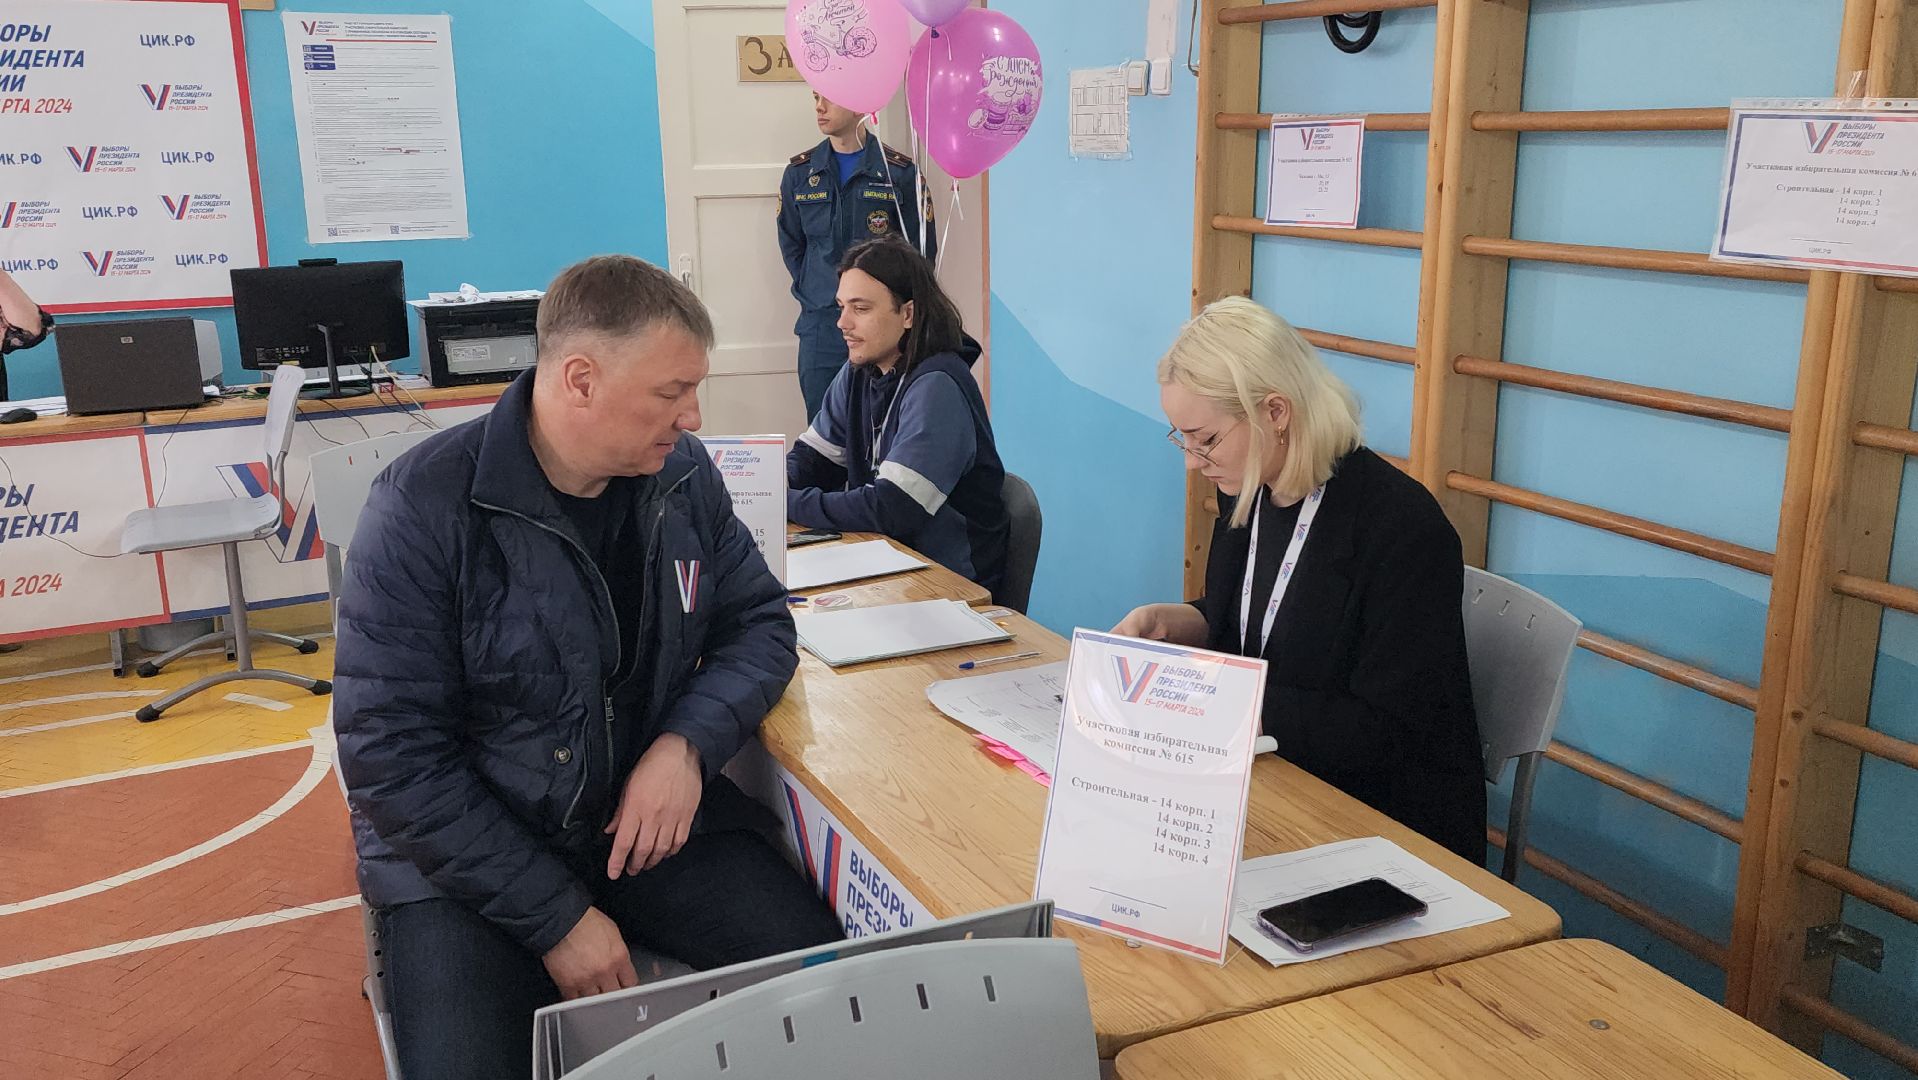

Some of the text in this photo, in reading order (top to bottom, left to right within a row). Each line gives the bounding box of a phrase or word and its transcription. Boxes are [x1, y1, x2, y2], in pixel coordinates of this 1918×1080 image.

[0, 24, 51, 42] ОРЫ
[140, 34, 195, 48] ЦИК.РФ
[0, 49, 84, 70] ИДЕНТА
[745, 37, 793, 75] ЗА
[1, 98, 72, 113] РТА 2024
[1836, 131, 1885, 140] ПРЕЗИДЕНТА
[1832, 140, 1863, 148] РОССИИ
[0, 153, 42, 165] ИК.РФ
[161, 151, 215, 165] ЦИК.РФ
[1842, 187, 1851, 195] 14
[1853, 189, 1876, 197] корп.
[1850, 199, 1873, 208] корп.
[82, 206, 138, 220] ЦИК.РФ
[1848, 209, 1872, 217] корп.
[1846, 219, 1869, 227] корп.
[2, 258, 58, 273] ЦИК.РФ
[175, 253, 229, 267] ЦИК.РФ
[0, 510, 79, 544] ДЕНТА
[755, 529, 765, 537] 15
[11, 573, 62, 597] 2024
[1162, 664, 1206, 681] ВЫБОРЫ
[1156, 676, 1217, 696] ПРЕЗИДЕНТА
[1149, 688, 1190, 703] РОССИИ
[1164, 702, 1187, 714] МАРТА
[1187, 706, 1205, 717] 2024
[1077, 715, 1229, 757] Участковая избирательная
[1158, 748, 1172, 761] №
[1175, 751, 1194, 765] 615
[1071, 776, 1149, 804] Строительная
[1161, 797, 1172, 809] 14
[1175, 803, 1206, 817] корп.
[1211, 809, 1215, 819] 1
[1158, 811, 1213, 834] 14 корп. 2
[1156, 827, 1211, 850] 14 корп. 3
[1154, 842, 1209, 865] 14 корп. 4
[850, 849, 914, 928] ВЫБОРЫ
[847, 881, 891, 934] ПРЕЗИ
[1111, 903, 1141, 919] ЦИК.РФ
